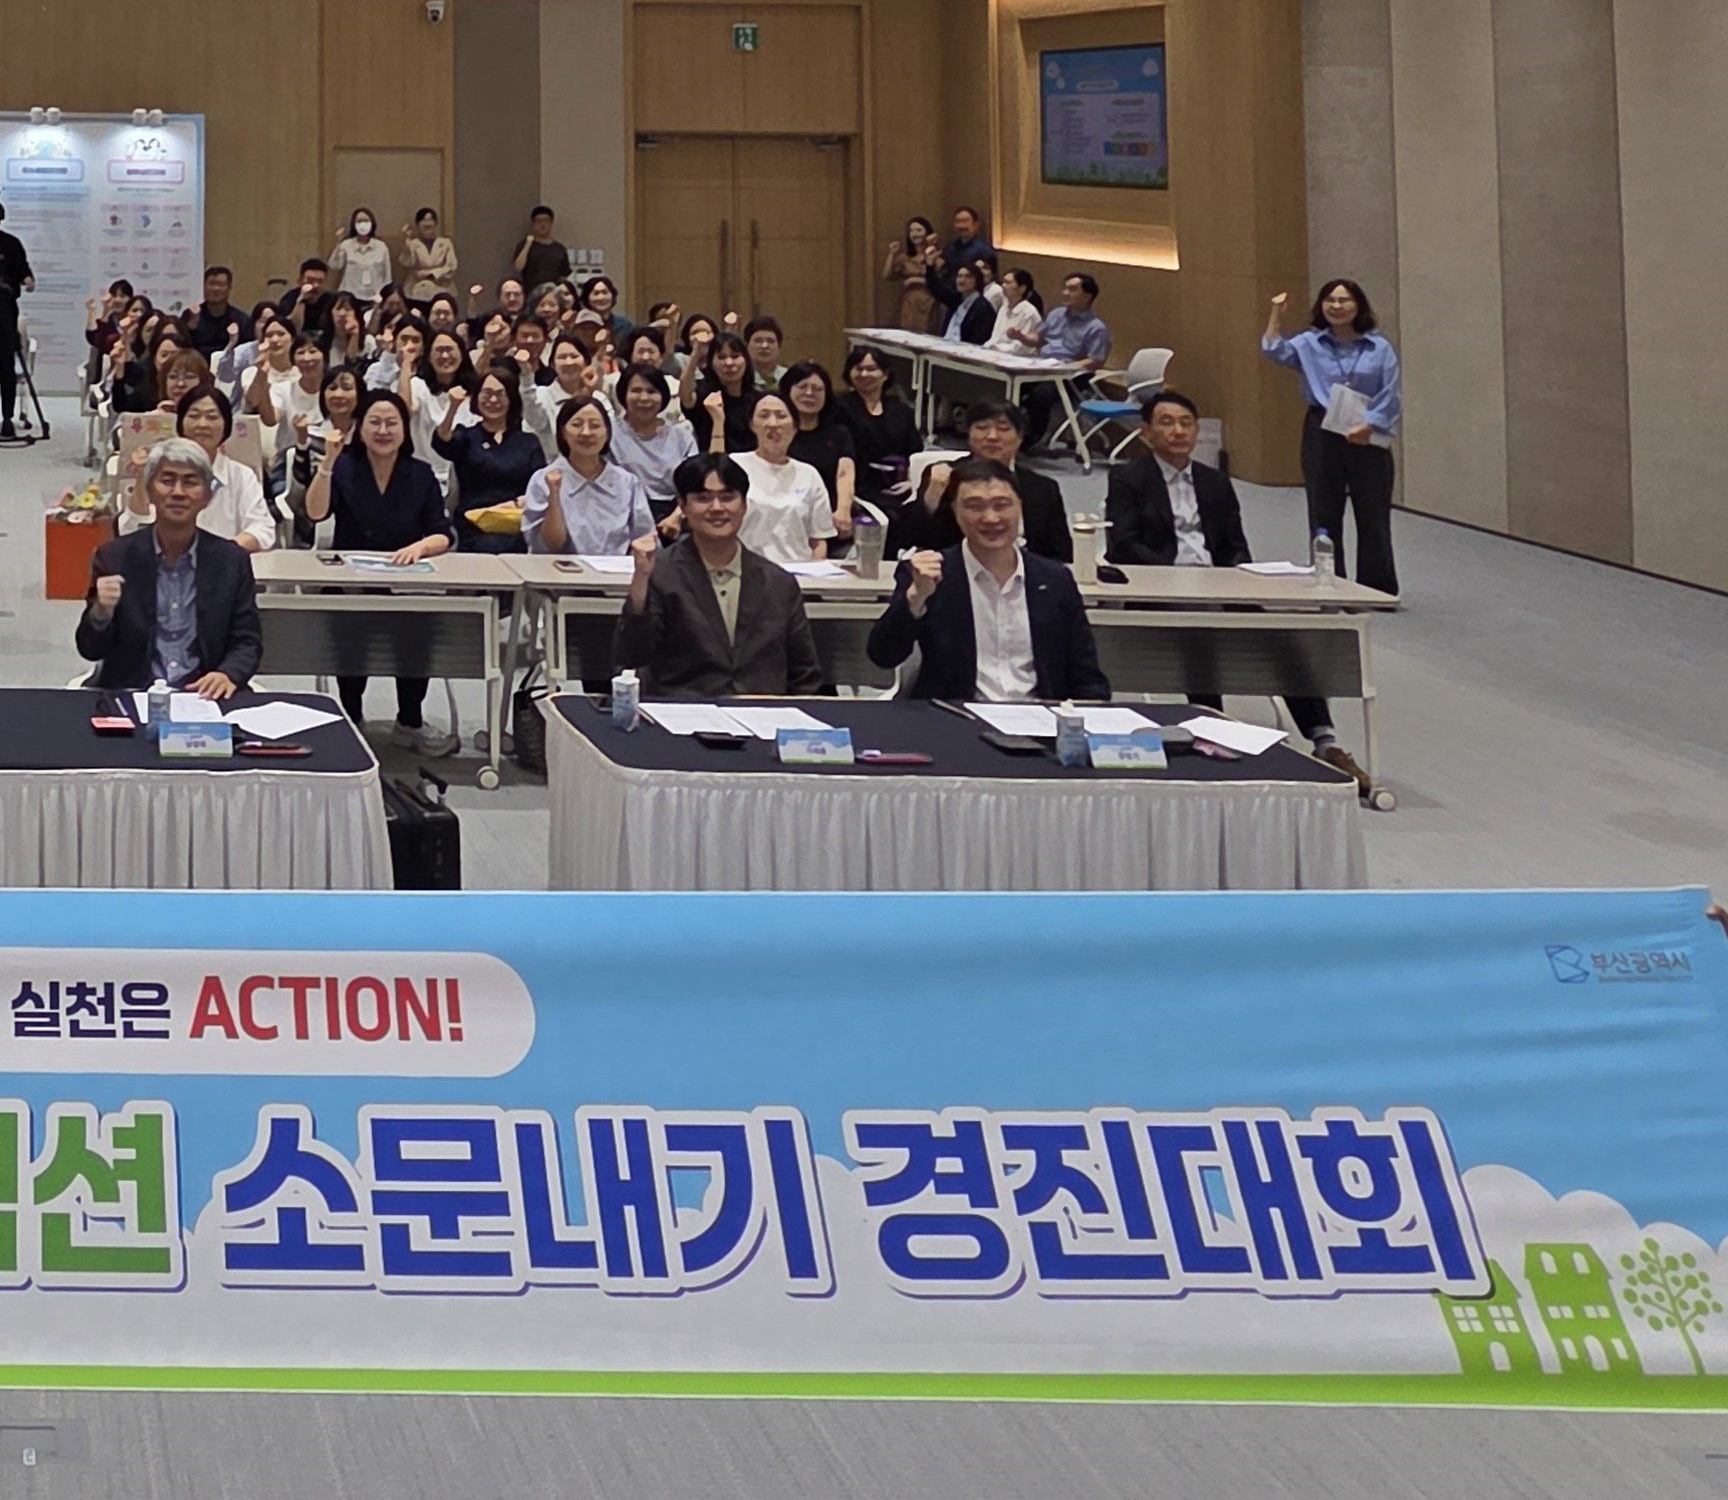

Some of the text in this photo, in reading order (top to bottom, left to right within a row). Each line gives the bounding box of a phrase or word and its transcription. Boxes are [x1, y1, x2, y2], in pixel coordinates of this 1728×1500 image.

[1589, 951, 1692, 974] 부산광역시
[10, 980, 171, 1040] 실천은
[189, 974, 464, 1042] ACTION!
[225, 1116, 815, 1277] 소문내기
[855, 1118, 1479, 1281] 경진대회
